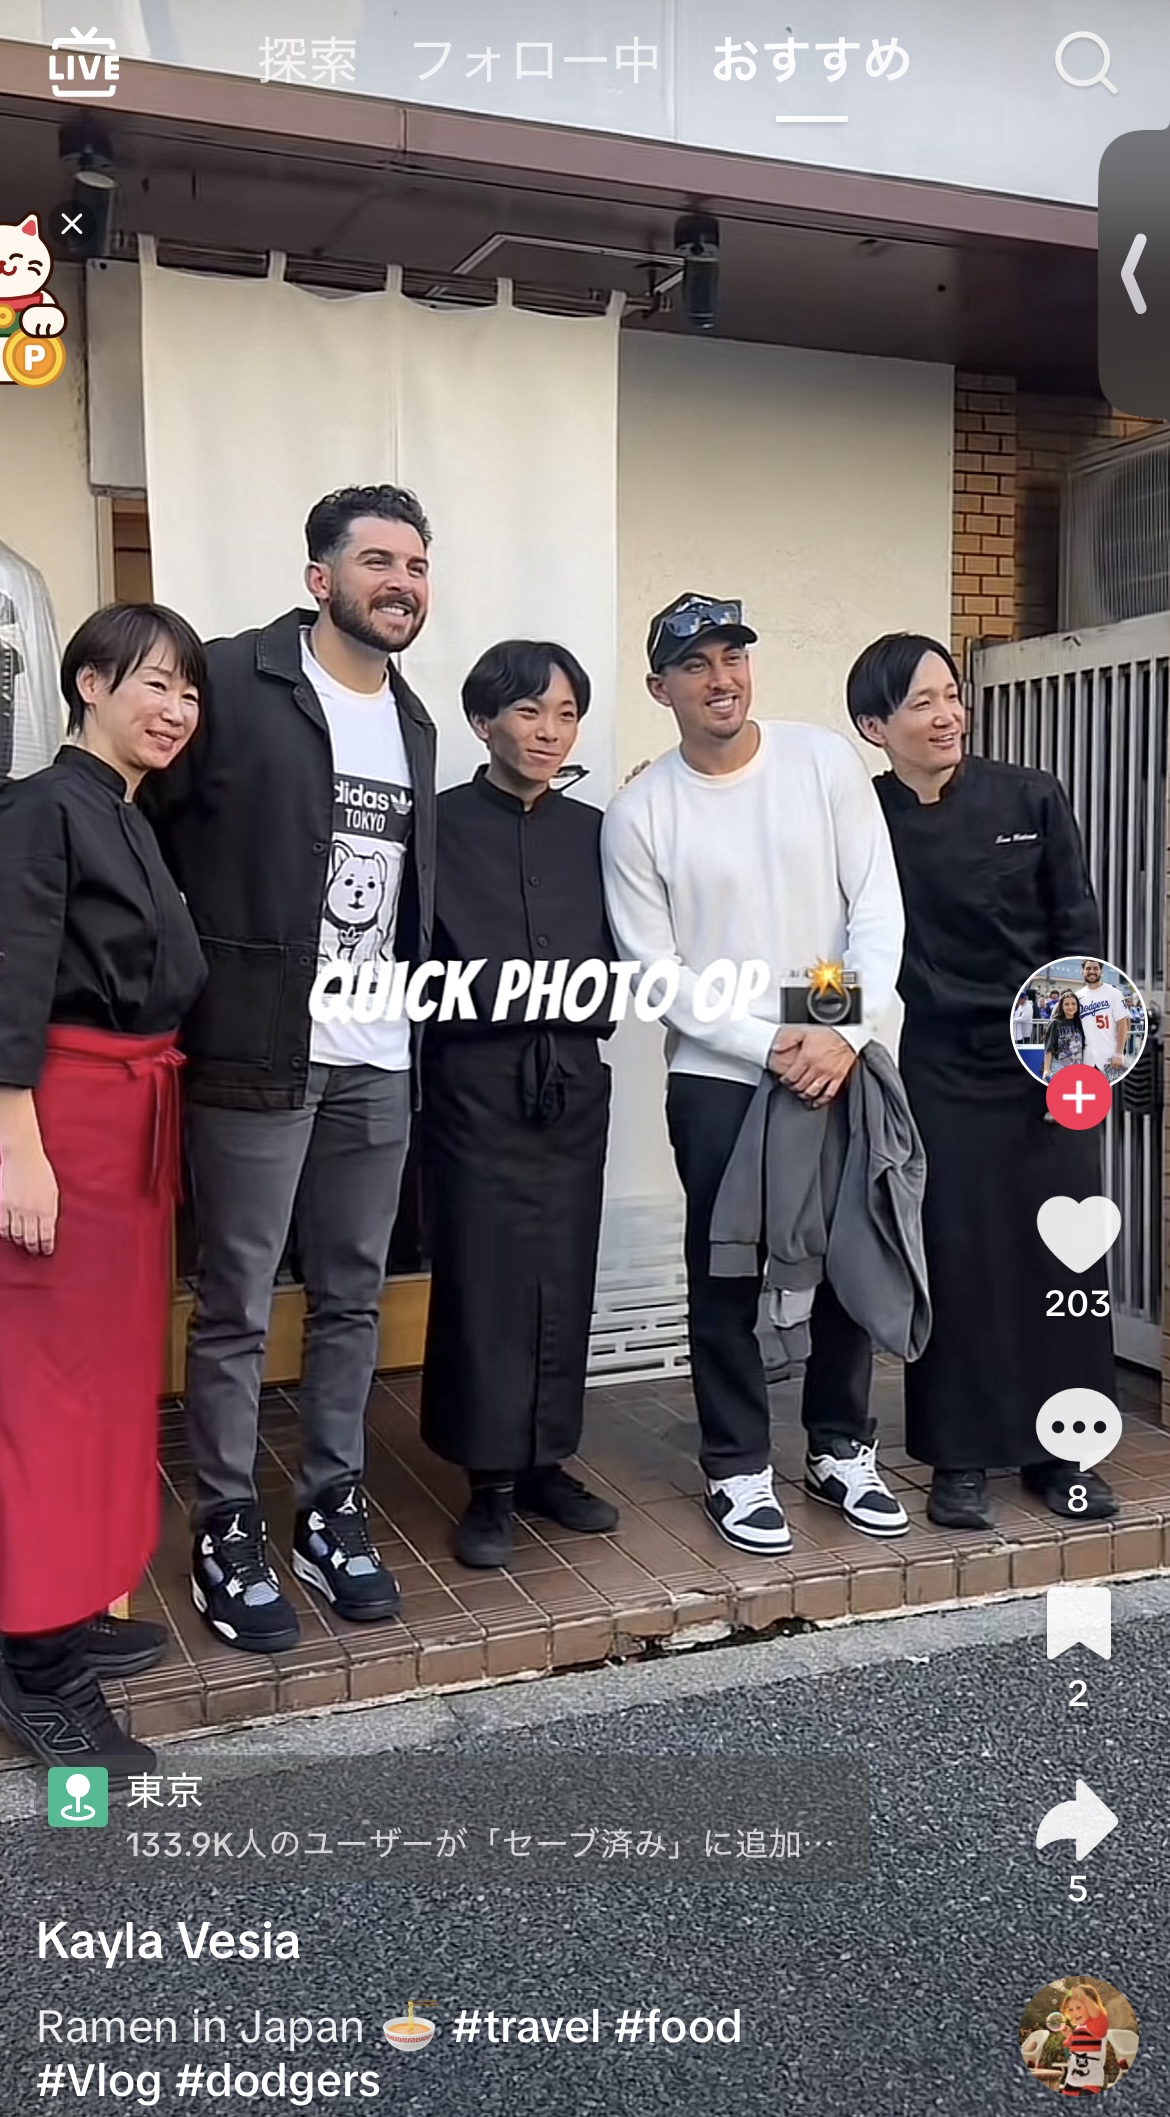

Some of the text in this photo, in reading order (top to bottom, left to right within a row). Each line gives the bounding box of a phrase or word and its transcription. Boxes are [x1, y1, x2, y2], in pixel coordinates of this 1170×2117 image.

[334, 780, 391, 811] didas
[345, 808, 387, 833] TOKYO
[1095, 1015, 1110, 1029] 51
